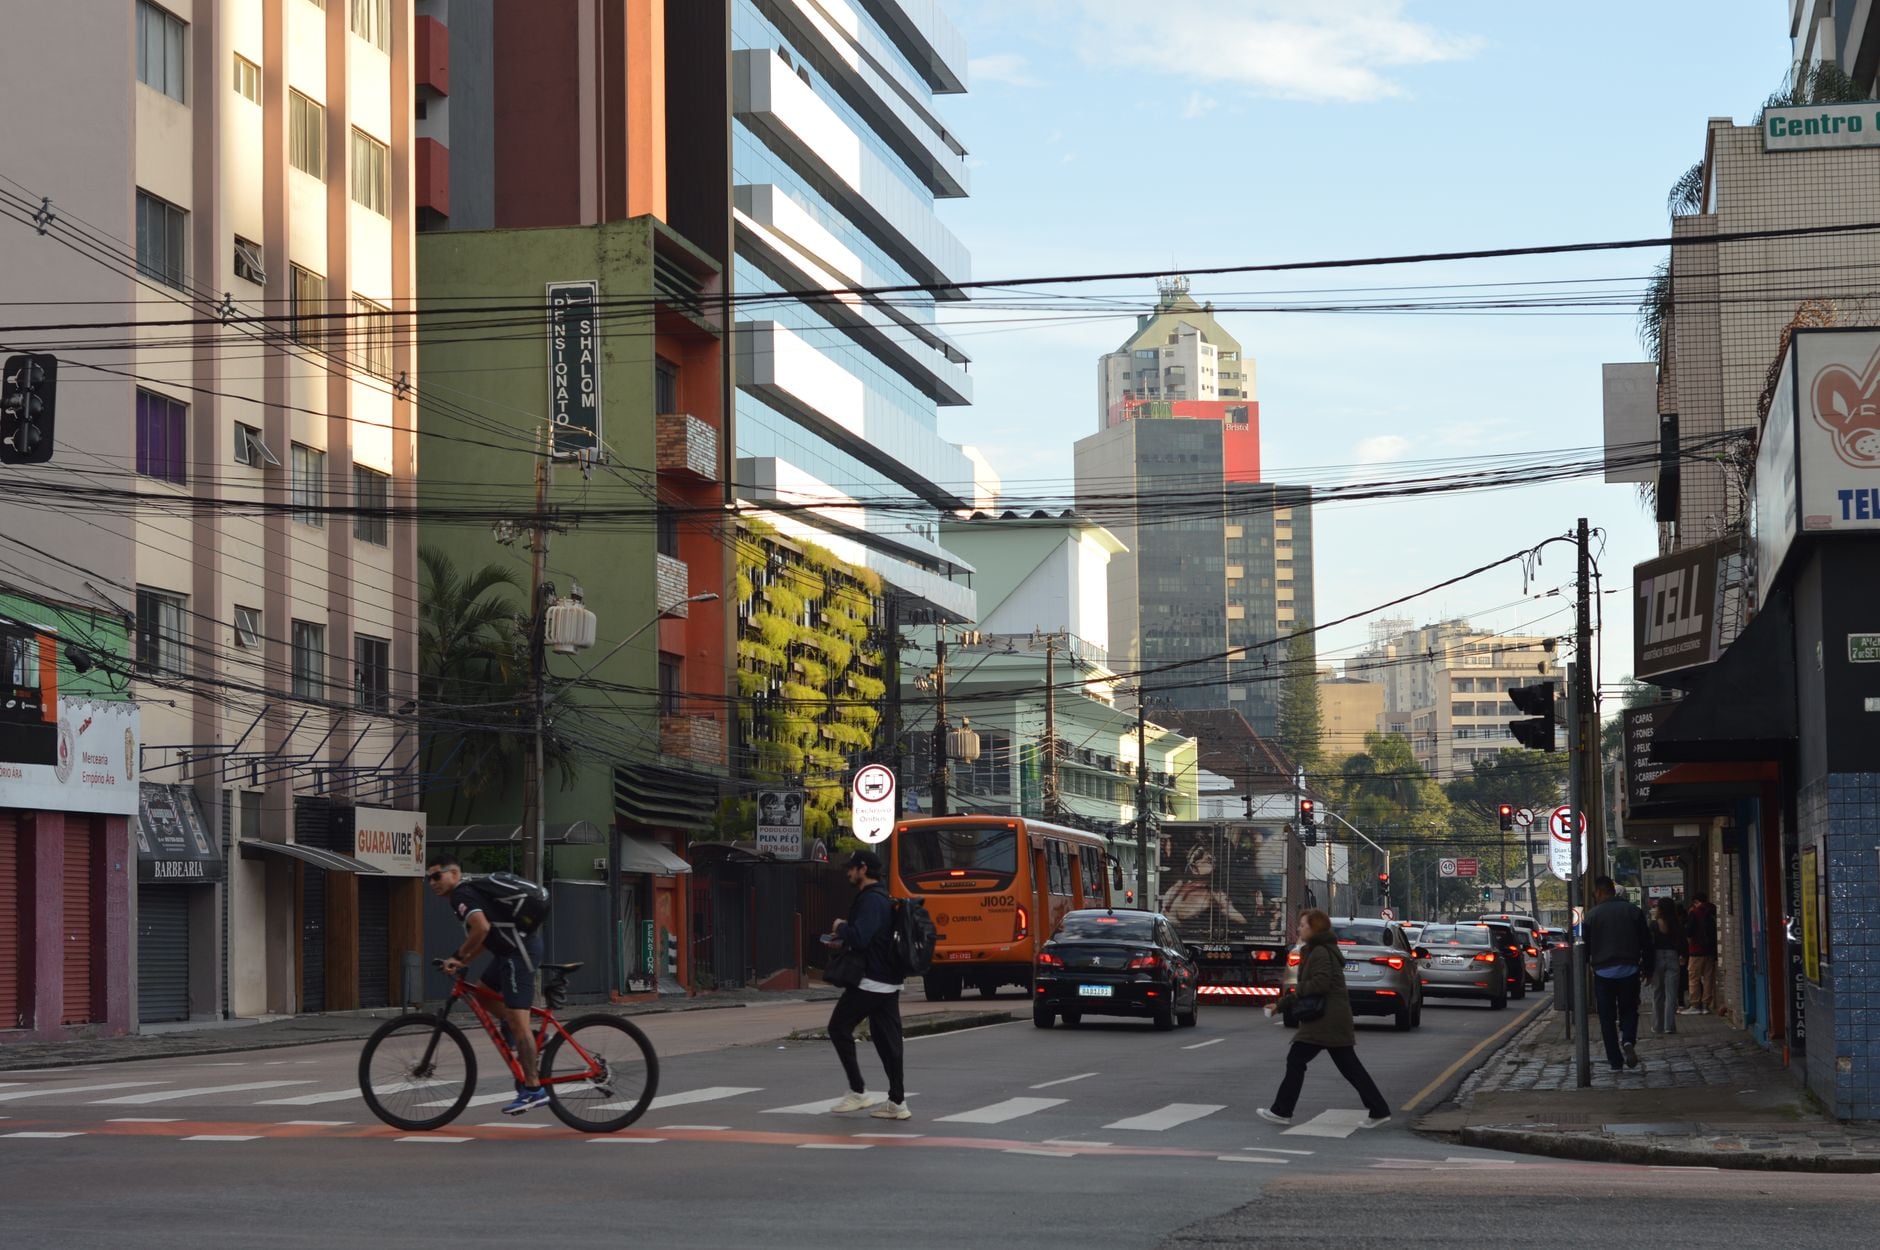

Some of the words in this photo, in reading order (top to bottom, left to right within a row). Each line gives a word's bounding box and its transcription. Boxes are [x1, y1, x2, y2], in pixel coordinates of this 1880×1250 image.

[1770, 114, 1862, 137] Centro
[580, 320, 595, 408] SHALOM
[1225, 423, 1249, 432] Bristol
[1838, 488, 1880, 520] TEL
[1852, 647, 1858, 659] 7
[1635, 713, 1653, 724] CAPAS
[1636, 728, 1654, 738] FONES
[82, 751, 108, 766] Mercearia
[358, 829, 412, 855] GUARAVIBE
[154, 861, 204, 878] BARBEARIA
[980, 896, 1014, 907] JI002
[1795, 973, 1806, 1038] CELULAR
